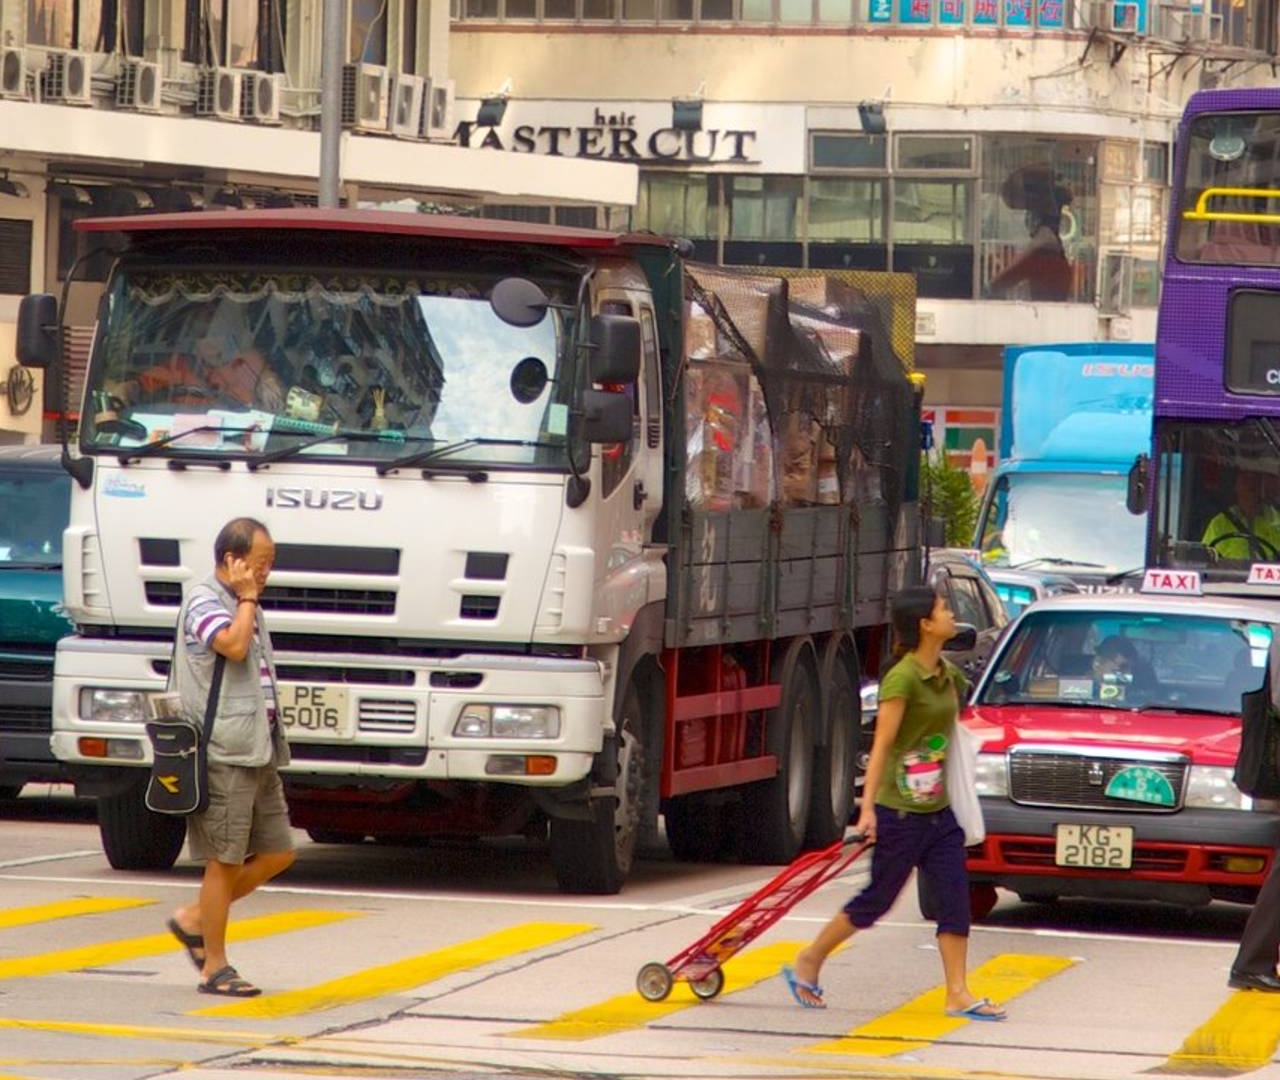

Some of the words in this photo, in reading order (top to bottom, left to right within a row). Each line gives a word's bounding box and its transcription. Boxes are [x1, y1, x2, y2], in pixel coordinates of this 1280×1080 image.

[594, 107, 636, 127] hair
[266, 487, 383, 511] ISUZU
[1075, 584, 1134, 595] SUZU
[1150, 573, 1196, 590] TAXI
[294, 686, 327, 706] PE
[1079, 825, 1111, 846] KG
[1064, 846, 1124, 869] 2182
